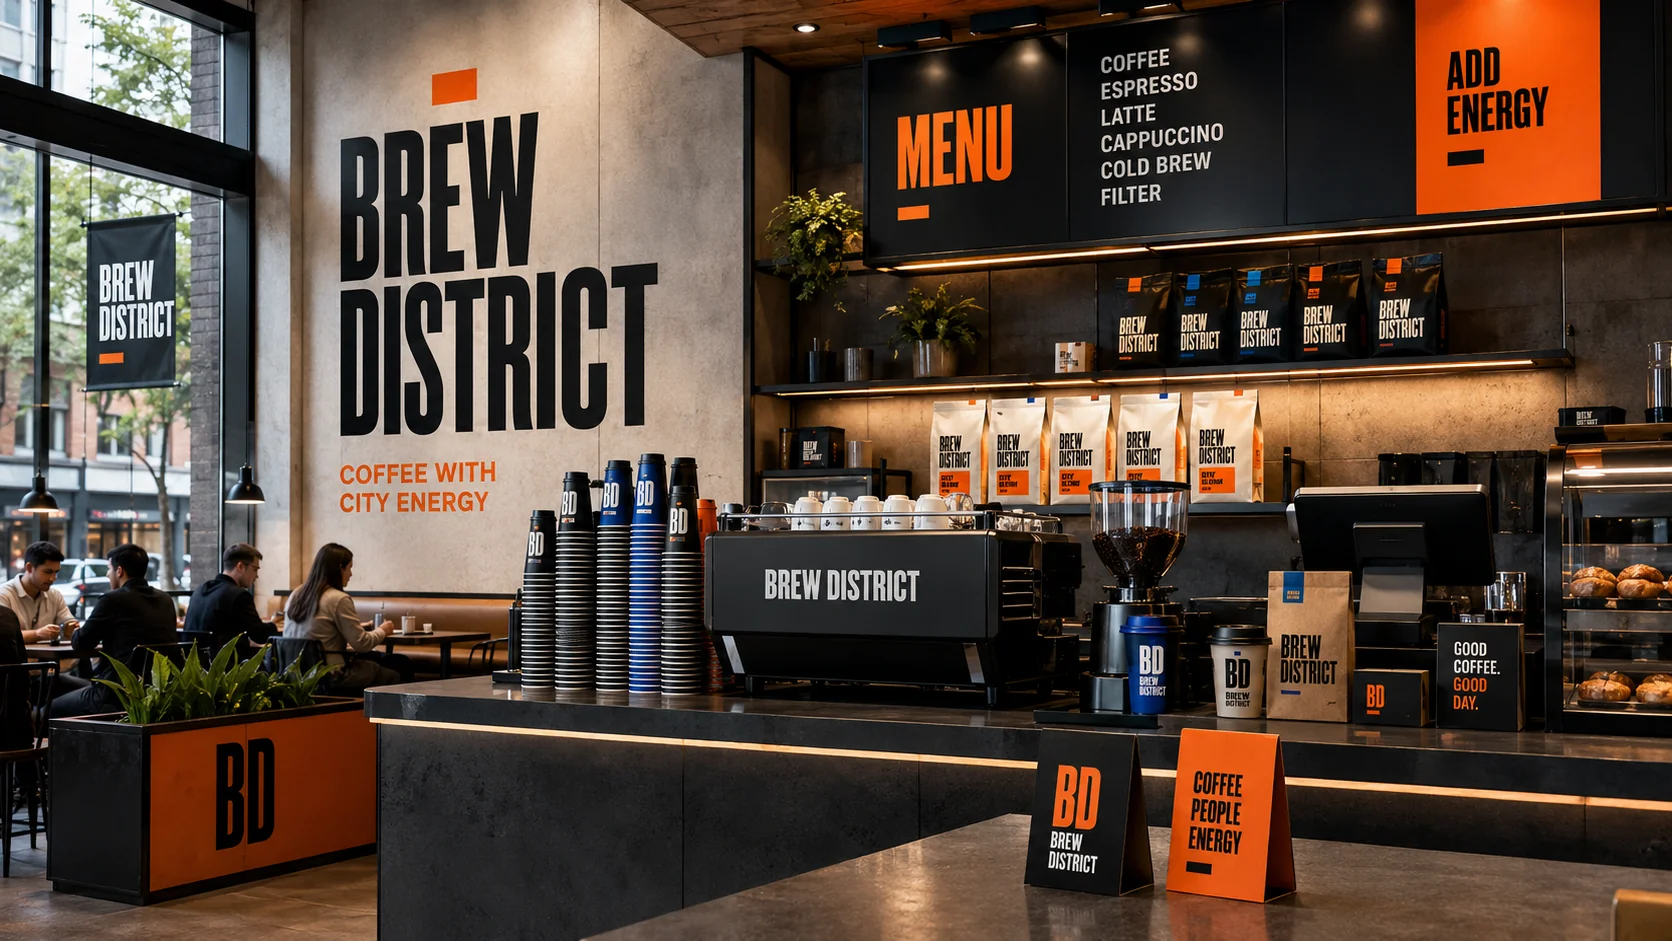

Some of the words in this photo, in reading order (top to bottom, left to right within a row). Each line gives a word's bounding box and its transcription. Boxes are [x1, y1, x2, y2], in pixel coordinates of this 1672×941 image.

[1100, 48, 1170, 74] COFFEE
[1447, 46, 1500, 90] ADD
[1101, 72, 1198, 100] ESPRESSO
[1102, 104, 1156, 126] LATTE
[1447, 86, 1548, 135] ENERGY
[898, 104, 1012, 190] MENU
[1100, 123, 1224, 152] CAPPUCCINO
[1100, 158, 1150, 180] COLD
[1156, 152, 1212, 174] BREW
[340, 112, 538, 282] BREW
[1102, 184, 1162, 206] FILTER
[99, 260, 154, 303] BREW
[1240, 310, 1268, 329] BREW
[1304, 305, 1333, 325] BREW
[1379, 298, 1411, 319] BREW
[99, 300, 174, 341] DISTRICT
[1119, 316, 1146, 335] BREW
[1181, 313, 1208, 332] BREW
[1379, 317, 1424, 339] DISTRICT
[1119, 334, 1159, 353] DISTRICT
[1181, 331, 1220, 351] DISTRICT
[1240, 328, 1281, 348] DISTRICT
[1304, 323, 1346, 344] DISTRICT
[340, 262, 658, 436] DISTRICT
[940, 436, 962, 451] BREW
[997, 434, 1020, 451] BREW
[1059, 433, 1082, 450] BREW
[1127, 431, 1151, 448] BREW
[1200, 429, 1224, 446] BREW
[939, 452, 971, 468] DISTRICT
[997, 451, 1030, 467] DISTRICT
[1059, 450, 1093, 466] DISTRICT
[1126, 448, 1161, 466] DISTRICT
[1200, 446, 1236, 464] DISTRICT
[340, 463, 427, 484] COFFEE
[435, 461, 496, 483] WITH
[340, 493, 390, 513] CITY
[397, 492, 488, 512] ENERGY
[562, 491, 577, 515] BD
[603, 482, 619, 508] BD
[637, 481, 654, 506] BD
[670, 508, 688, 534] BD
[528, 532, 544, 556] BD
[765, 569, 821, 600] BREW
[827, 570, 920, 602] DISTRICT
[1281, 635, 1321, 659] BREW
[1454, 642, 1487, 656] GOOD
[1139, 645, 1164, 675] BD
[1454, 660, 1500, 674] COFFEE.
[1140, 676, 1158, 686] BREW
[1226, 659, 1250, 688] BD
[1281, 660, 1337, 685] DISTRICT
[1454, 677, 1487, 692] GOOD
[1367, 684, 1384, 708] BD
[1453, 695, 1478, 710] DAY.
[216, 738, 274, 850] BD
[1193, 771, 1243, 798] COFFEE
[1052, 765, 1101, 830] BD
[1191, 798, 1241, 826] PEOPLE
[1050, 831, 1083, 851] BREW
[1188, 826, 1242, 854] ENERGY
[1048, 851, 1098, 874] DISTRICT
